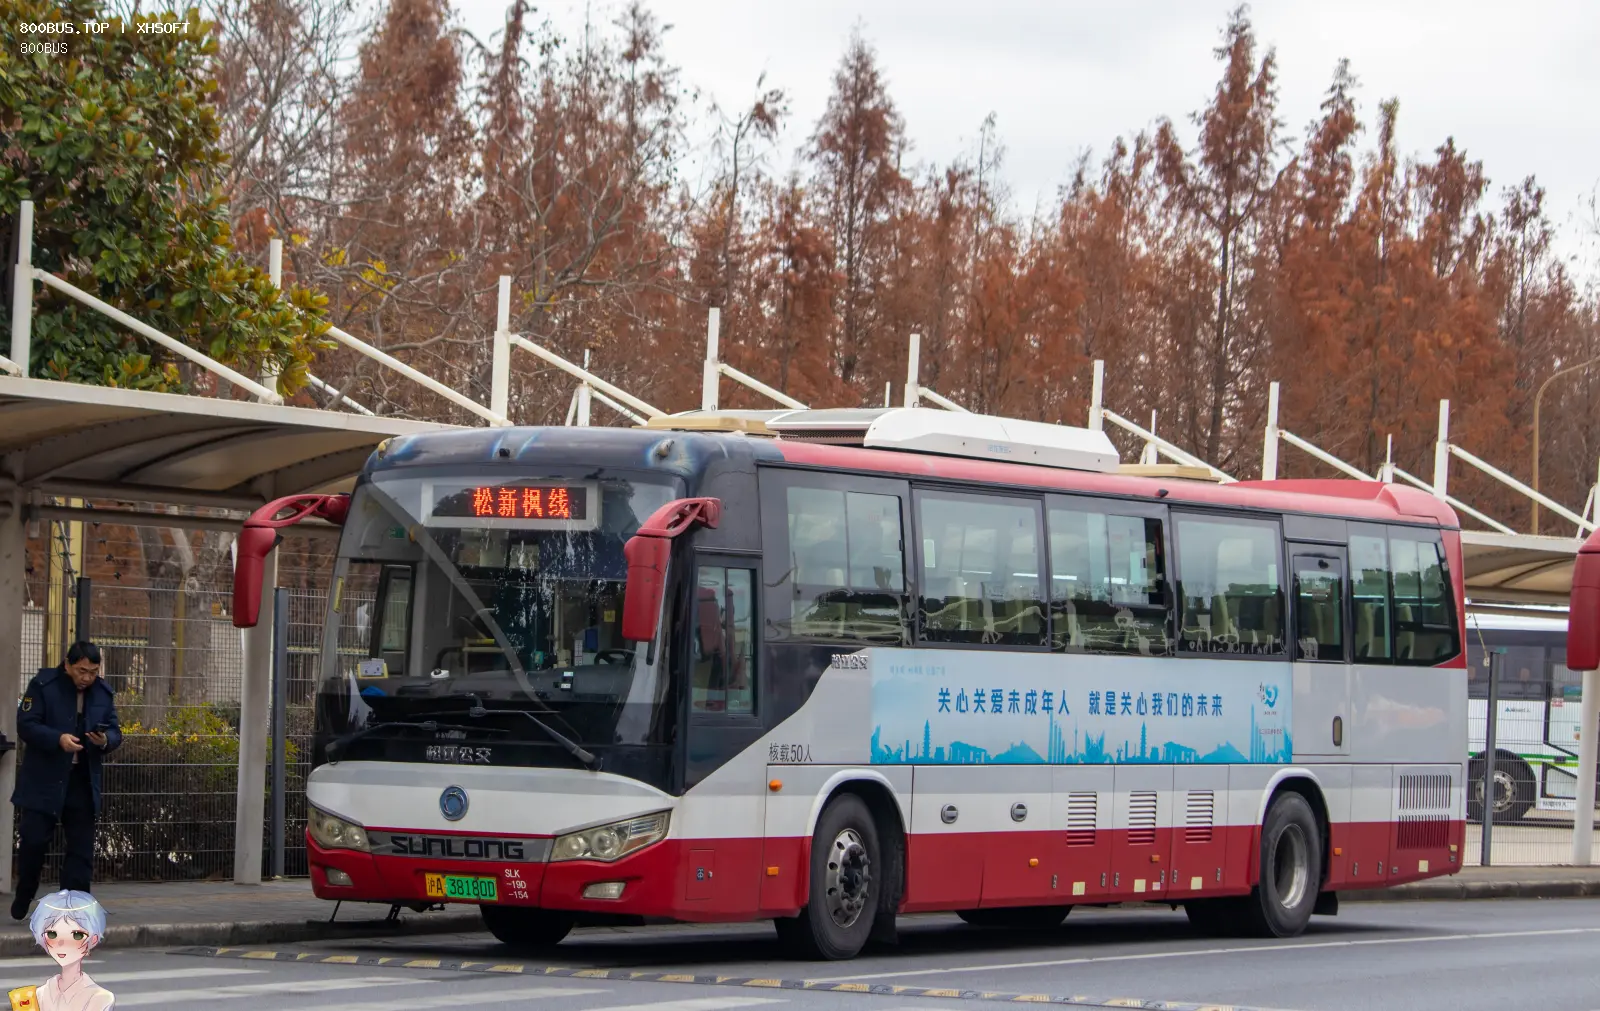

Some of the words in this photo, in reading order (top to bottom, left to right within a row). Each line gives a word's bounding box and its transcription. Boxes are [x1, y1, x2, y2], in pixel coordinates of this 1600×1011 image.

[473, 487, 569, 518] 松新枫线
[938, 687, 1070, 716] 关心关爱未成年人
[1088, 690, 1223, 717] 就是关心我们的未来
[768, 742, 813, 763] 核载50人
[390, 835, 524, 860] SUNLONG
[504, 868, 520, 878] SLK
